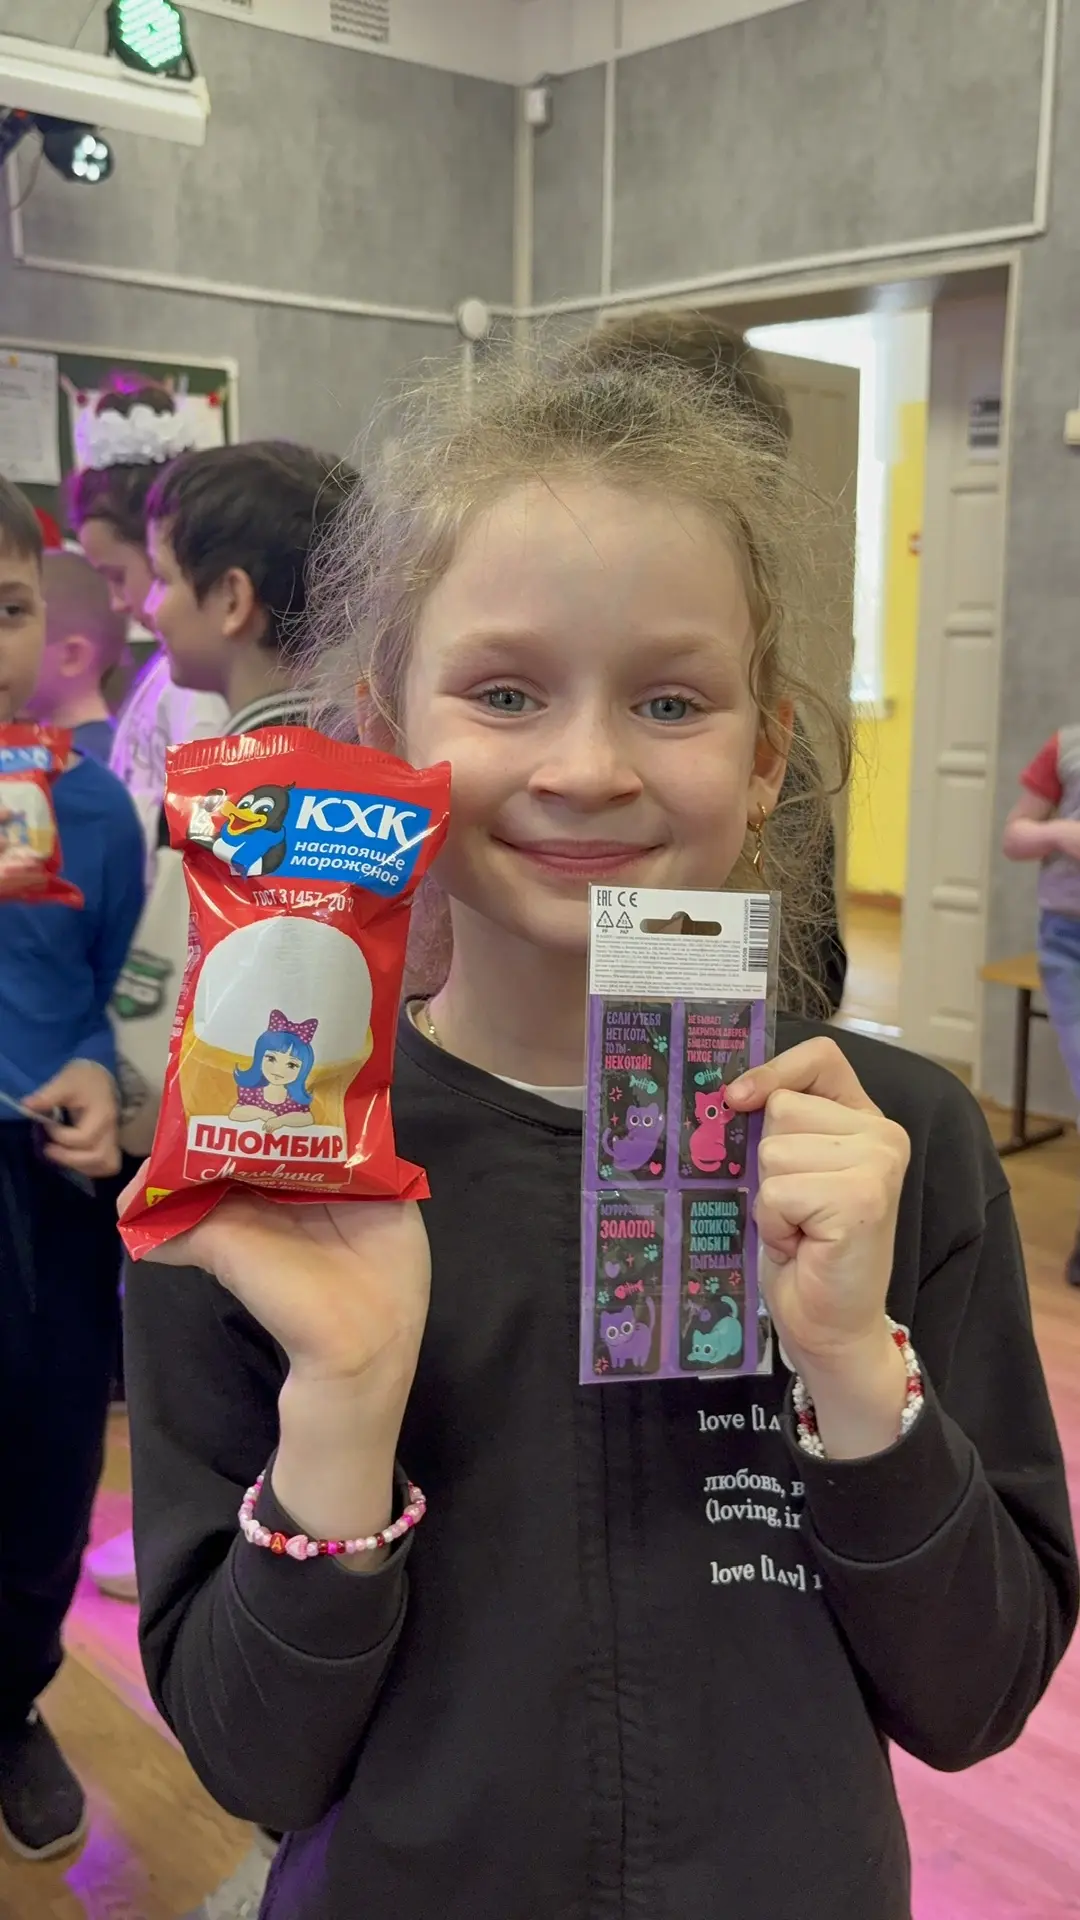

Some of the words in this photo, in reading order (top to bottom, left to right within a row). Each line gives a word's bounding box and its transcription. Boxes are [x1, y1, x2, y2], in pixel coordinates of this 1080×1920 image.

[295, 795, 417, 849] КХК
[294, 841, 406, 871] настоящее
[290, 856, 400, 886] мороженое
[252, 888, 278, 907] ГОСТ
[606, 1011, 631, 1025] ЕСЛИ
[632, 1012, 639, 1026] У
[639, 1012, 661, 1027] ТЕБЯ
[606, 1027, 624, 1041] НЕТ
[623, 1028, 650, 1043] КОТА,
[605, 1042, 615, 1054] ТО
[615, 1042, 627, 1054] ТЫ
[686, 1049, 713, 1063] ТИХОЕ
[713, 1050, 732, 1064] МЯУ
[604, 1053, 652, 1070] НЕКОТЯЙ!
[195, 1123, 343, 1159] ПЛОМБИР
[690, 1201, 739, 1217] ЛЮБИШЬ
[599, 1219, 656, 1239] ЗОЛОТО!
[690, 1219, 740, 1236] КОТИКОВ,
[690, 1236, 721, 1252] ЛЮБИ
[722, 1236, 731, 1251] И
[697, 1409, 745, 1432] love
[703, 1468, 786, 1498] любовь,
[709, 1561, 755, 1585] love
